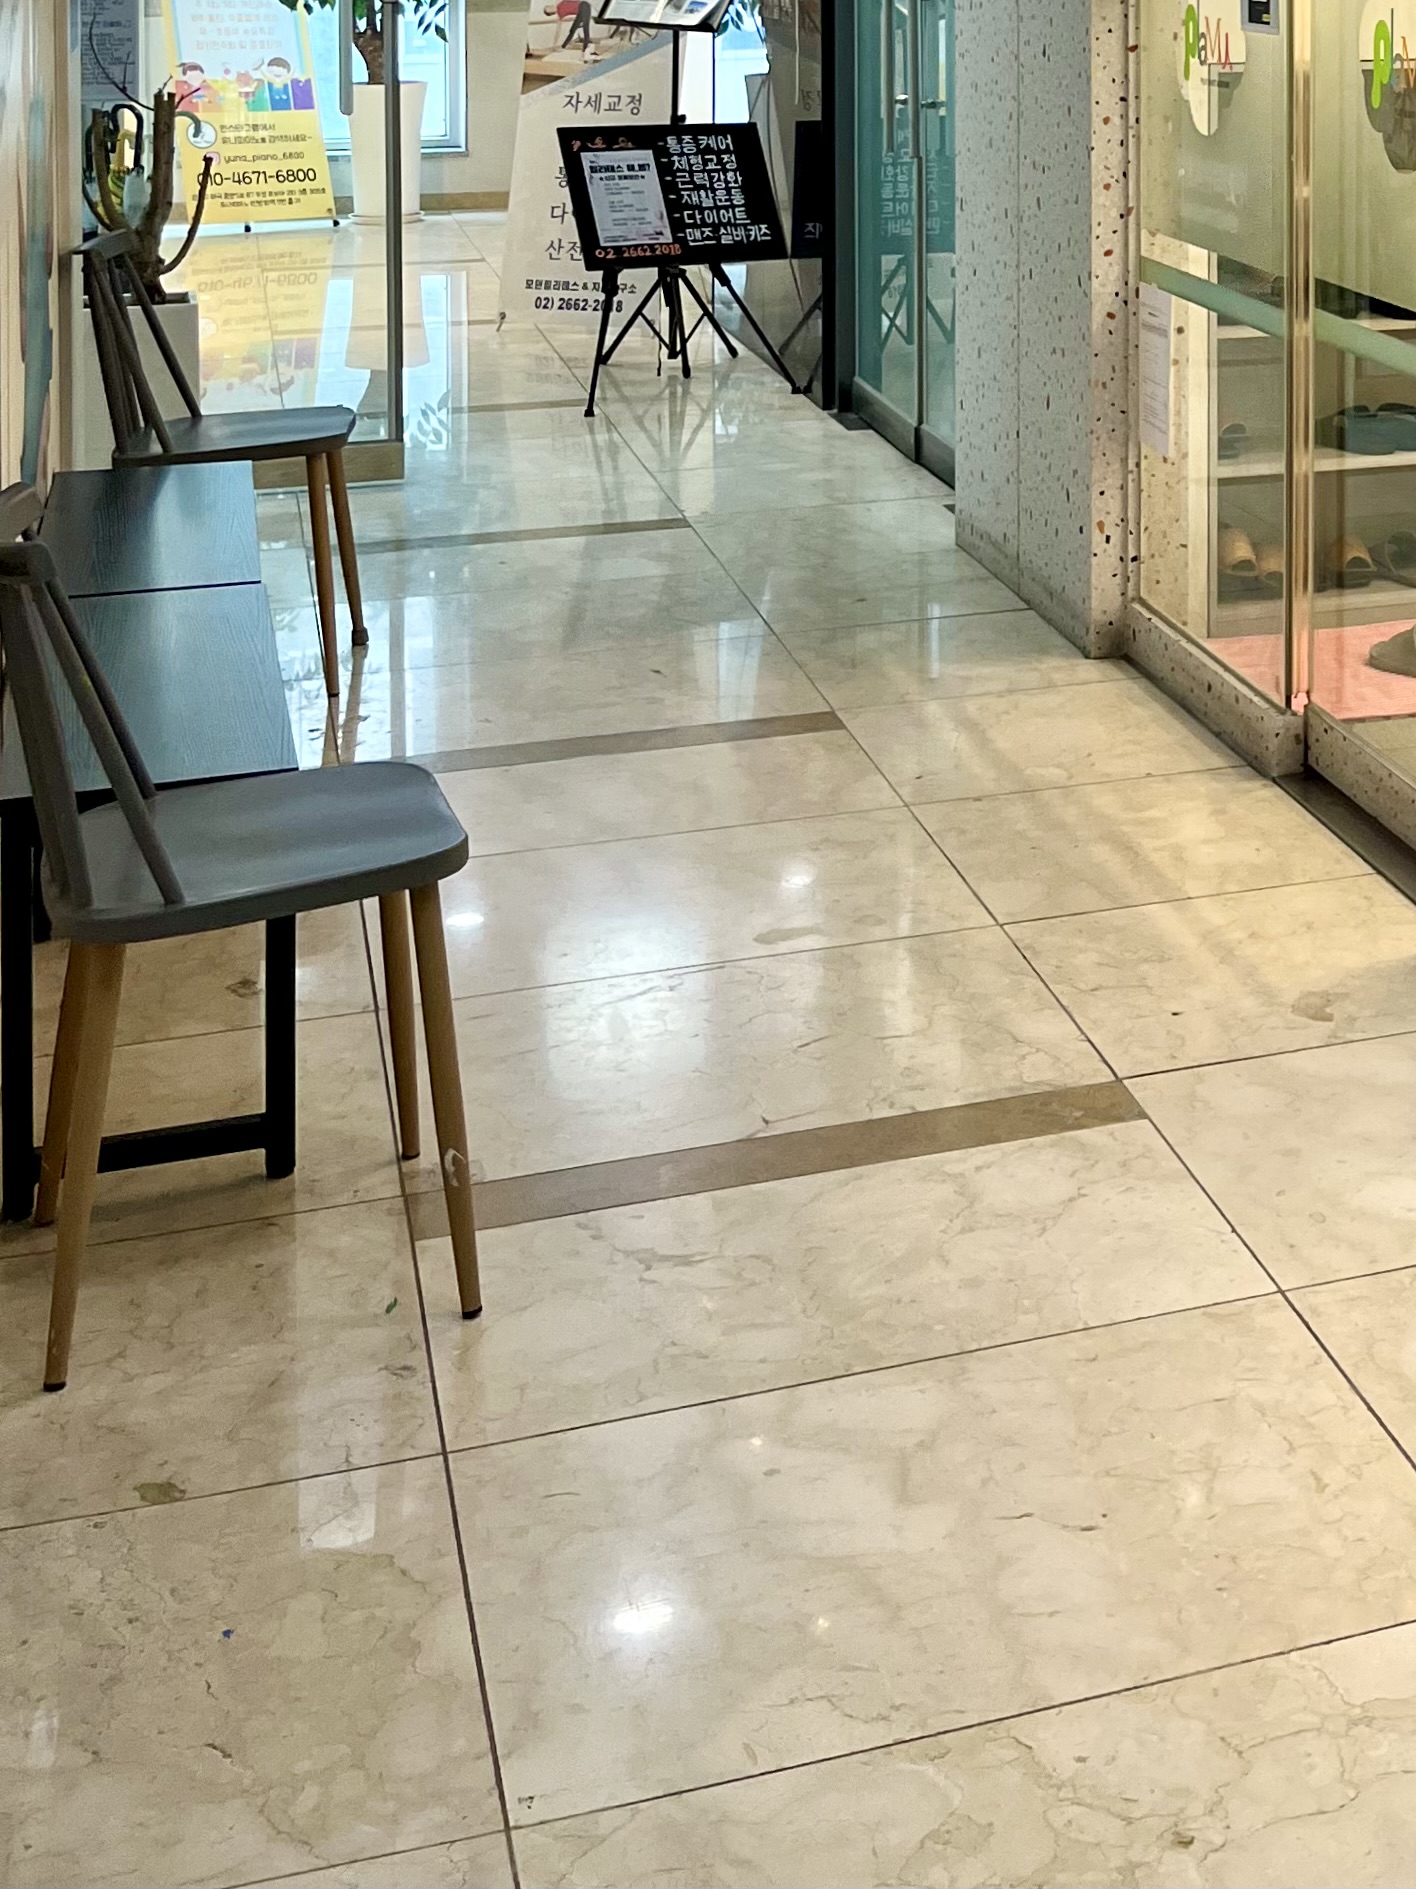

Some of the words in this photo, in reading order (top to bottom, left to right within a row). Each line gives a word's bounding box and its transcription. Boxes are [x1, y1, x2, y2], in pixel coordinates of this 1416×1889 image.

[563, 91, 643, 115] 자세교정
[223, 151, 305, 164] yuna_piano_6800
[535, 296, 554, 310] 02)
